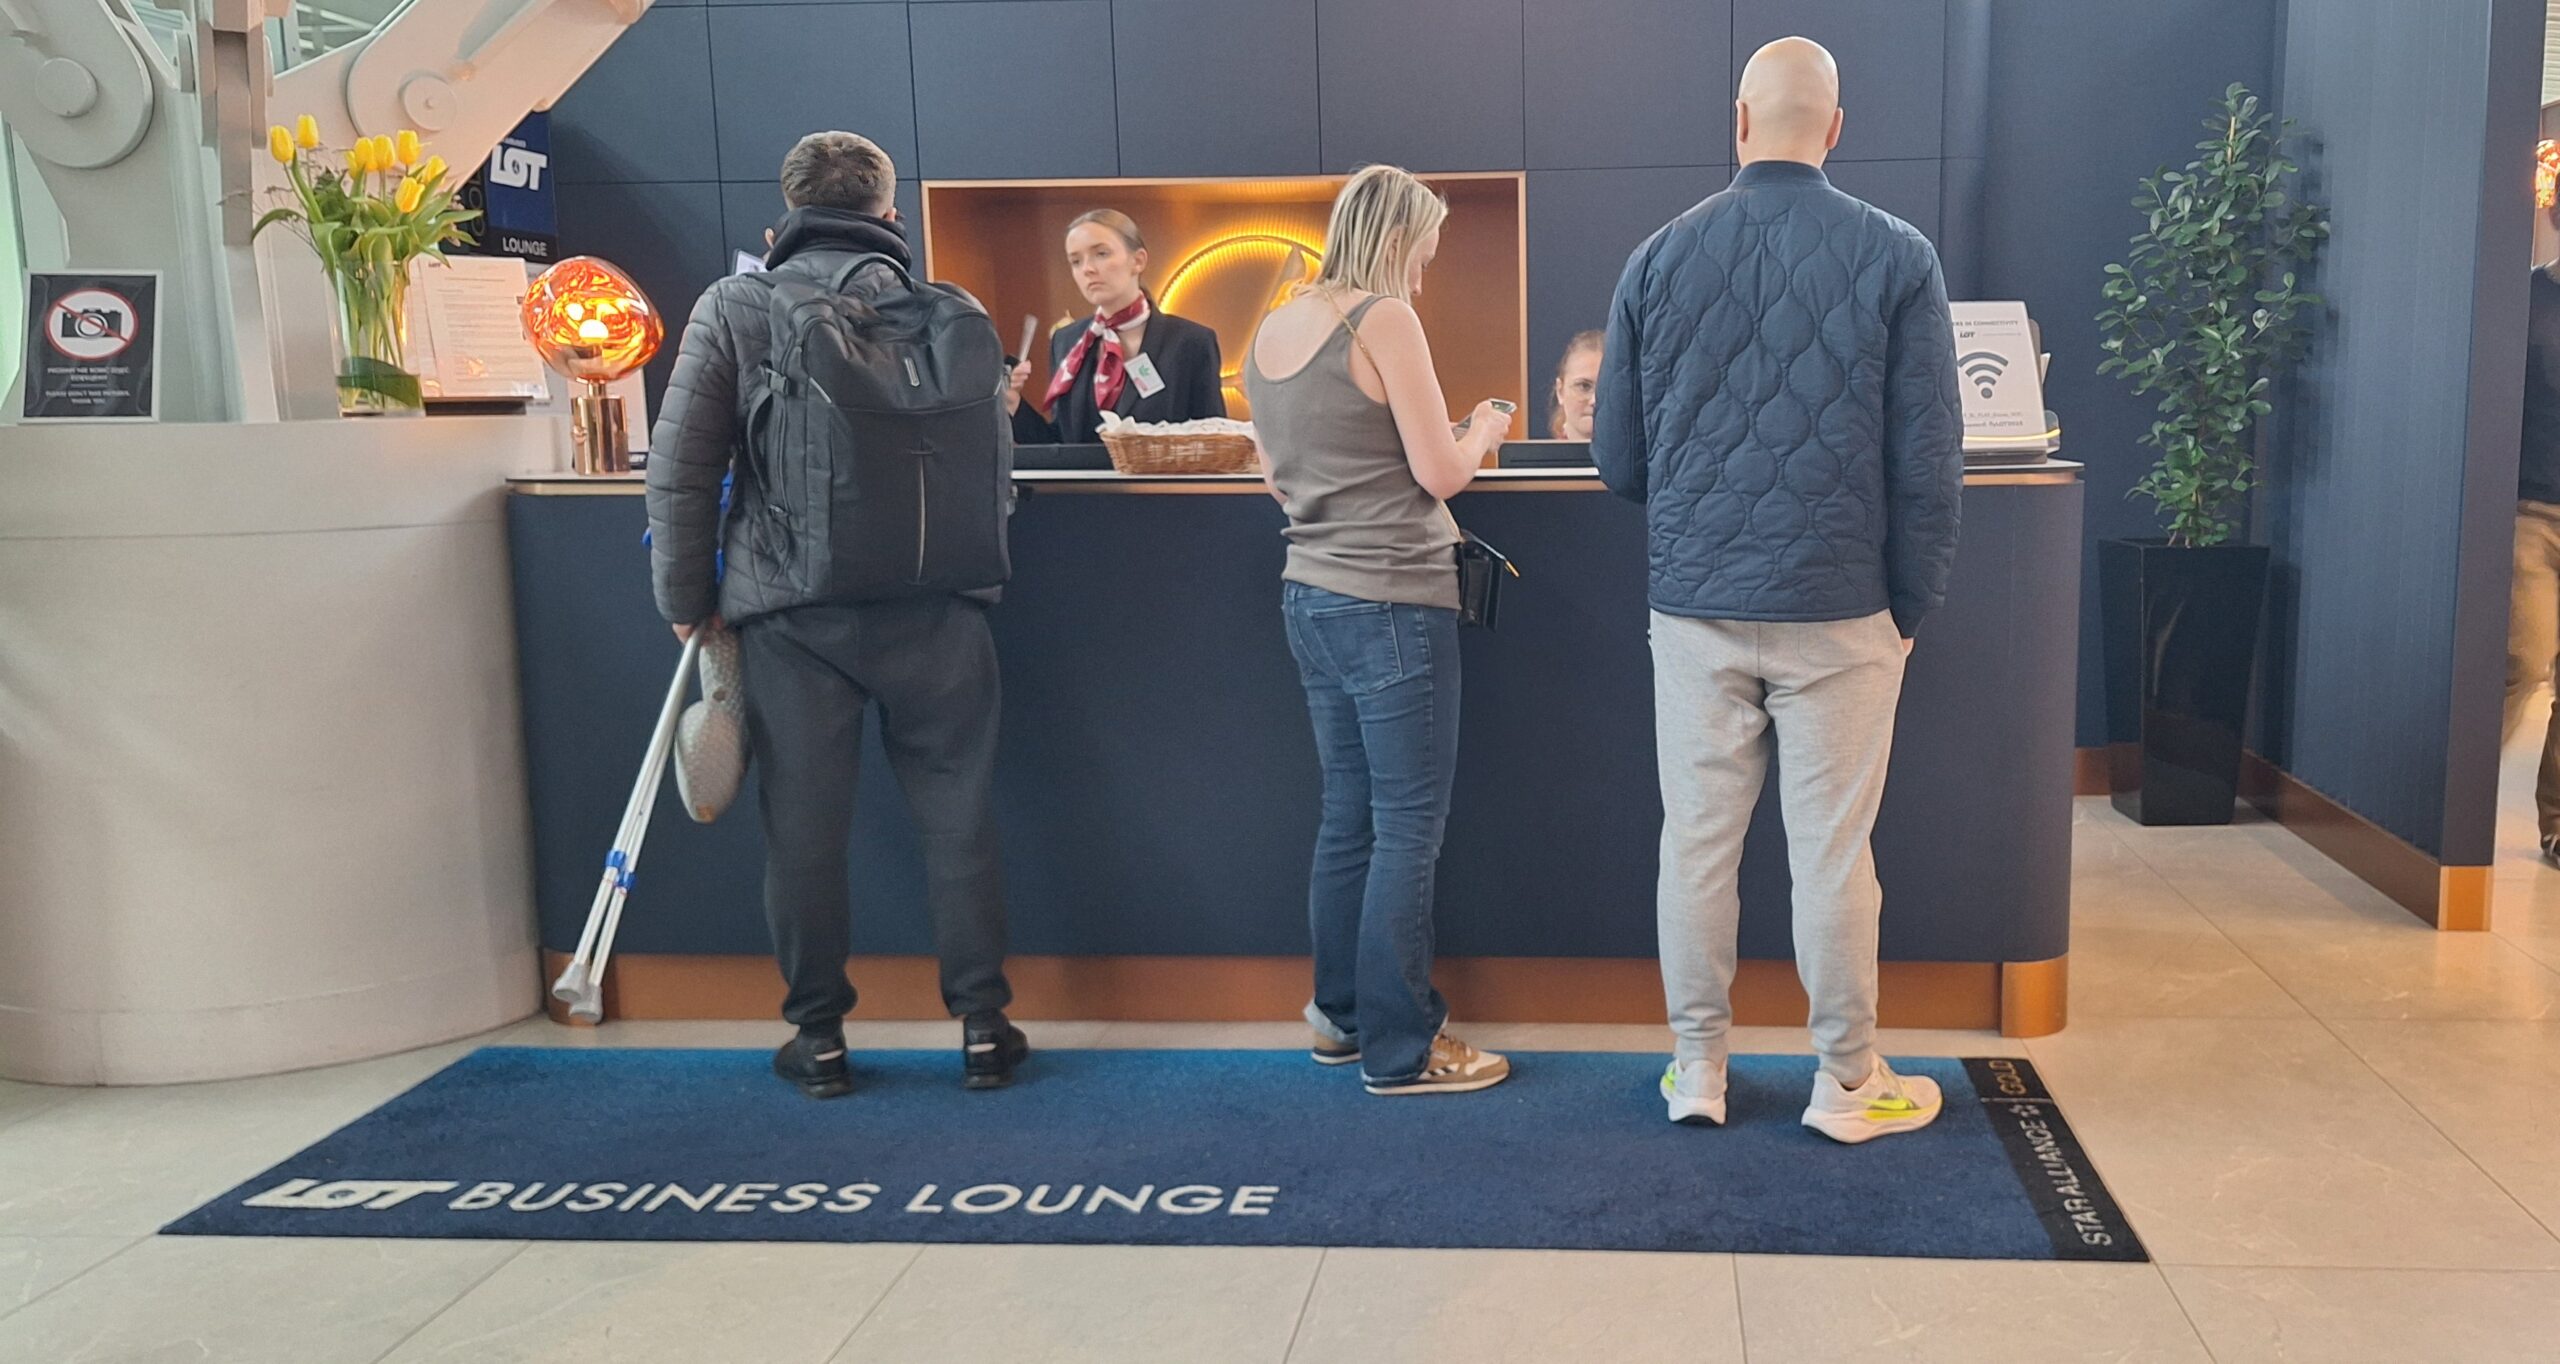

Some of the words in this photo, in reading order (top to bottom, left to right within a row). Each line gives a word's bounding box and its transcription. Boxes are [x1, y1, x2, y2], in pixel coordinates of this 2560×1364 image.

[490, 144, 548, 191] LOT
[502, 237, 548, 257] LOUNGE
[1988, 1060, 2028, 1096] GOLD
[2019, 1119, 2086, 1197] ALLIANCE
[241, 1178, 460, 1210] LOT
[448, 1182, 882, 1213] BUSINESS
[905, 1184, 1280, 1215] LOUNGE
[2063, 1198, 2113, 1247] STAR
